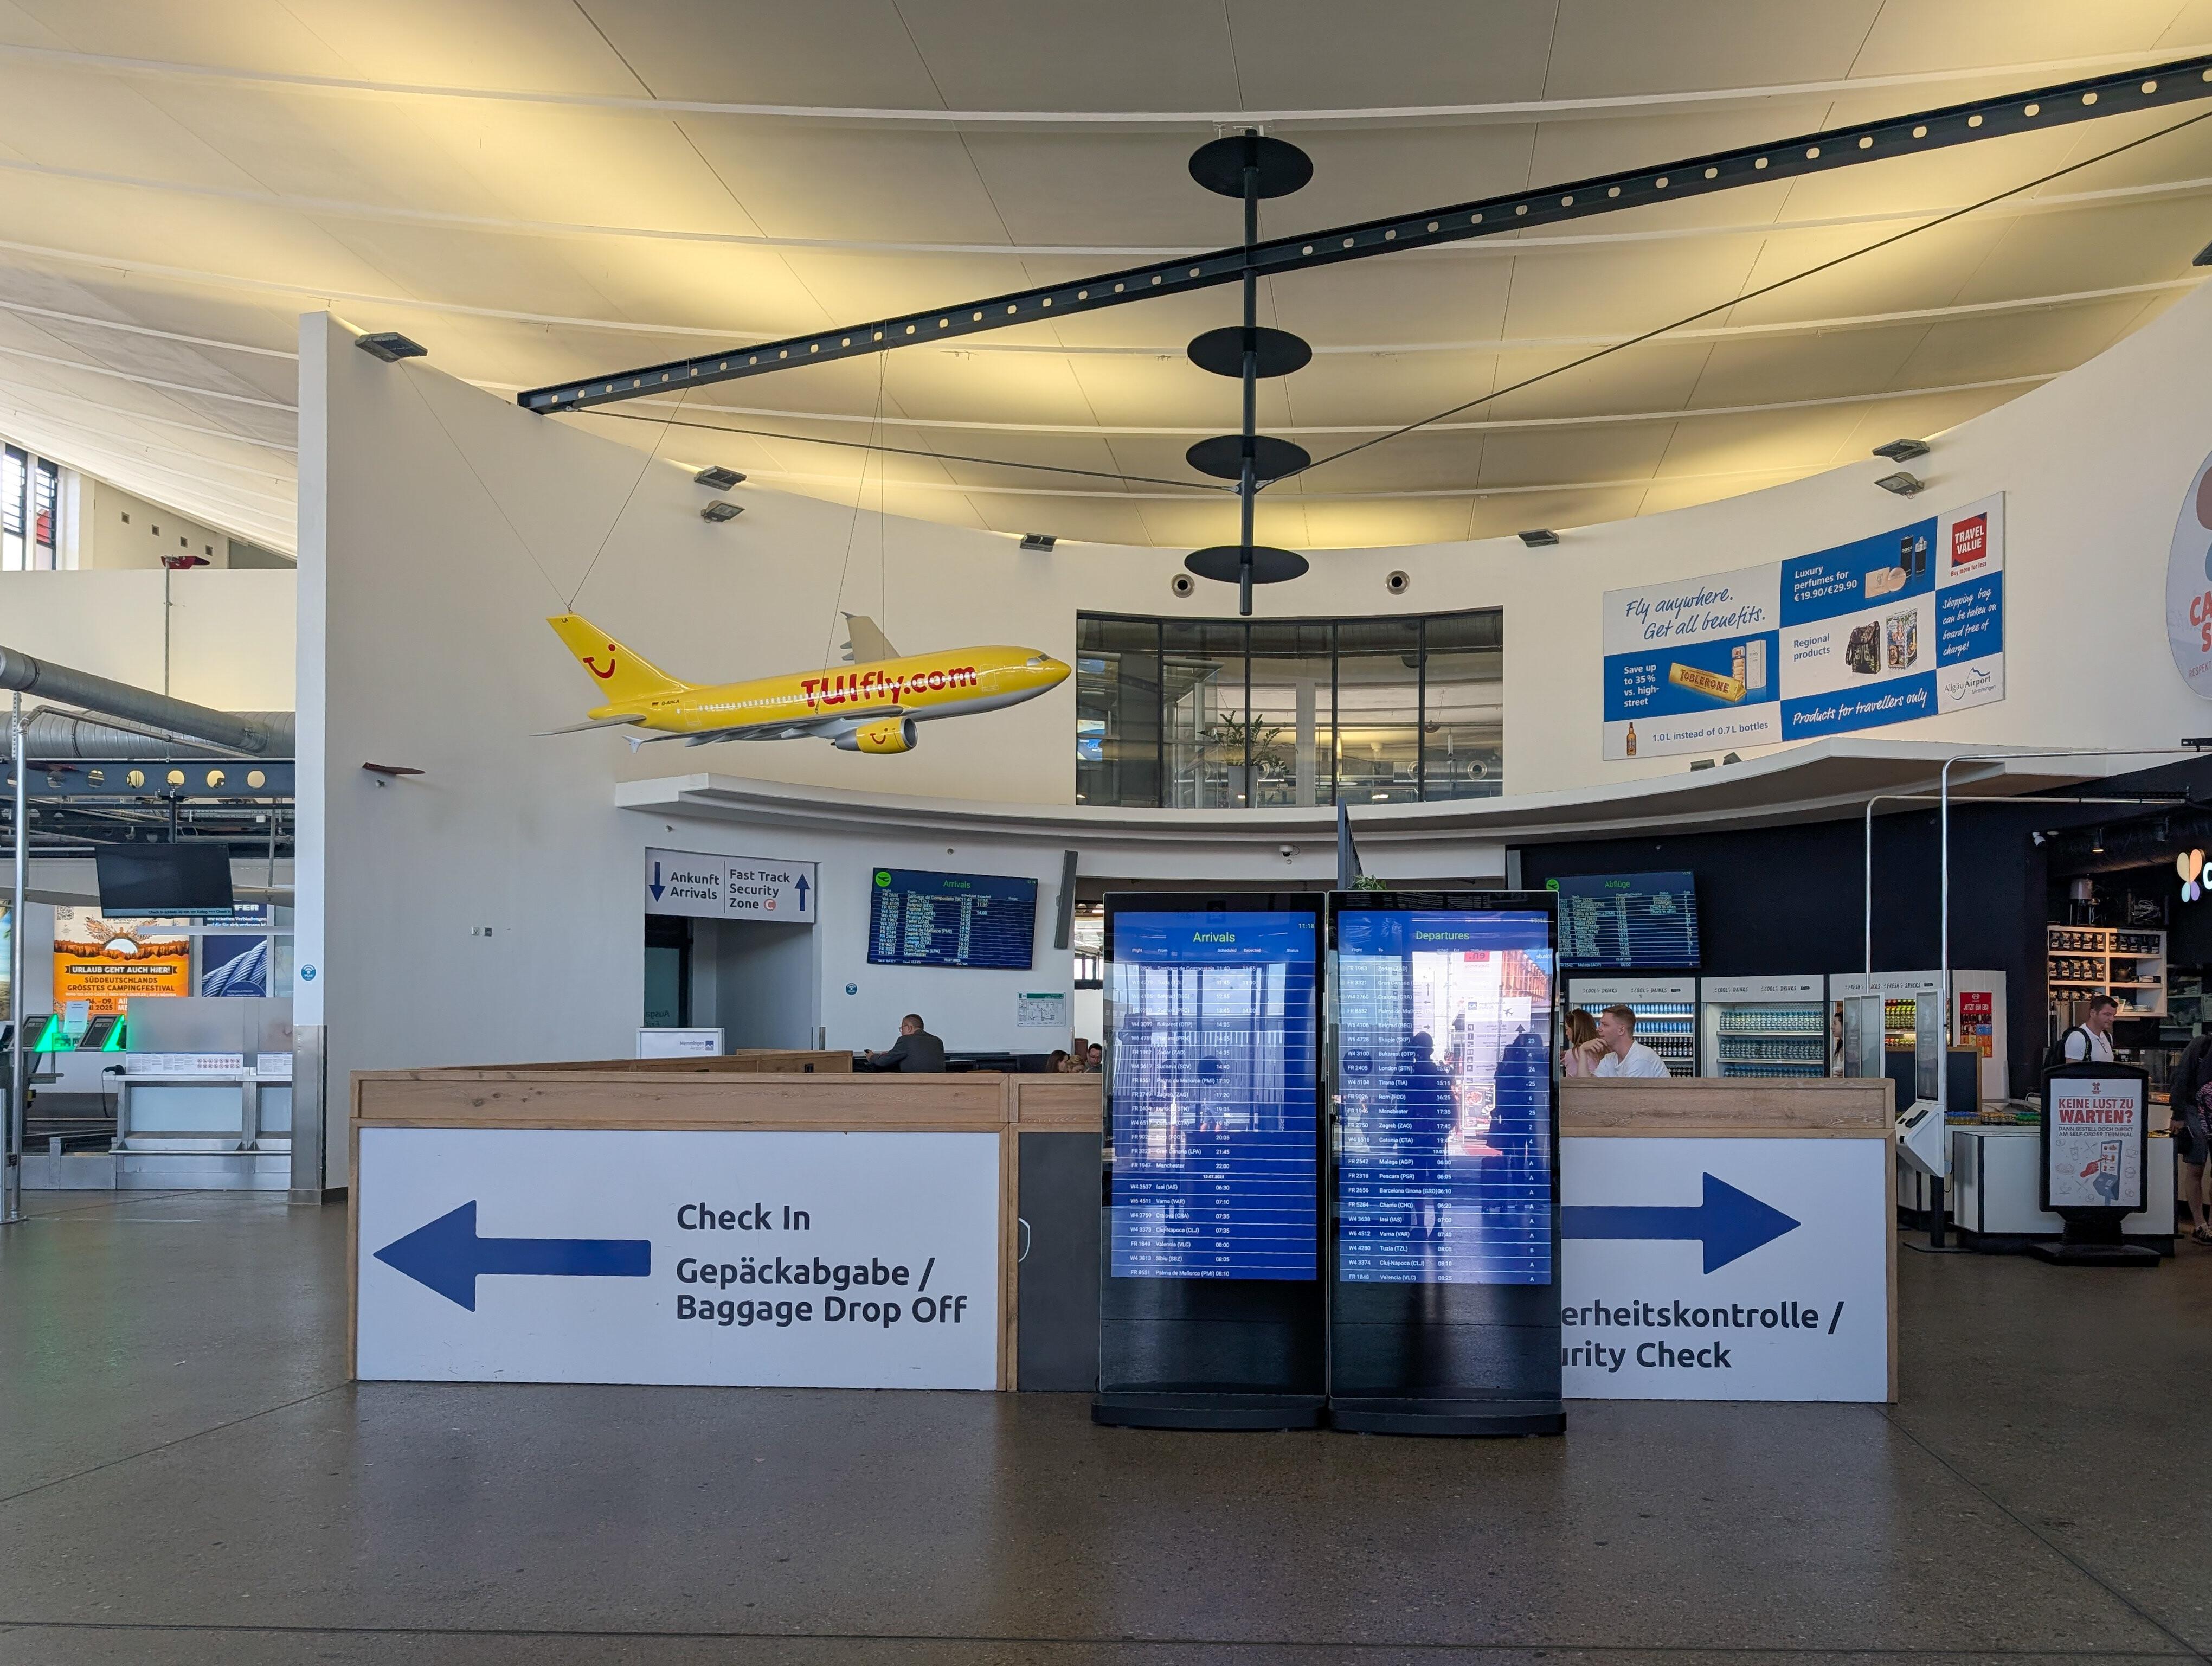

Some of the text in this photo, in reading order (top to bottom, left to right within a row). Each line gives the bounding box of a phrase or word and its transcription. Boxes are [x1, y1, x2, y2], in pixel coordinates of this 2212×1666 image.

[1955, 525, 1984, 544] TRAVEL
[1957, 538, 1982, 555] VALUE
[1795, 566, 1823, 579] Luxury
[1794, 570, 1849, 592] perfumes for
[1626, 586, 1733, 624] Fly anywhere.
[1943, 588, 1991, 610] Shopping bag
[1943, 603, 1997, 625] can be taken on
[1644, 606, 1765, 639] Get all benefits.
[1943, 619, 1989, 640] board free of
[1793, 633, 1830, 649] Regional
[1943, 641, 1969, 657] charge!
[1794, 646, 1830, 662] products
[1624, 664, 1656, 674] Save up
[2189, 661, 2212, 678] RESPEKT
[1624, 677, 1632, 685] to
[1680, 669, 1729, 694] TOBLERONE
[1944, 683, 1964, 694] Allgäu
[1965, 675, 1991, 688] Airport
[1972, 684, 1996, 694] Memmingen
[1638, 685, 1660, 697] high-
[1624, 697, 1648, 707] street
[1793, 688, 1928, 725] Products for travellers only
[1674, 729, 1703, 740] instead
[1706, 727, 1715, 736] of
[1739, 721, 1769, 732] bottles
[670, 872, 719, 885] Ankunft
[730, 869, 790, 883] Fast Track
[730, 883, 779, 898] Security
[943, 880, 970, 889] Arrivals
[670, 887, 717, 900] Arrivals
[730, 898, 759, 909] Zone
[1193, 932, 1235, 942] Arrivals
[1416, 931, 1470, 941] Departures
[2059, 1099, 2133, 1109] KEINE LUST ZU
[2059, 1110, 2133, 1124] WARTEN?
[677, 1202, 810, 1230] Check In
[676, 1256, 910, 1291] Gepäckabgabe
[677, 1294, 968, 1329] Baggage Drop Off
[1636, 1341, 1732, 1368] Check
